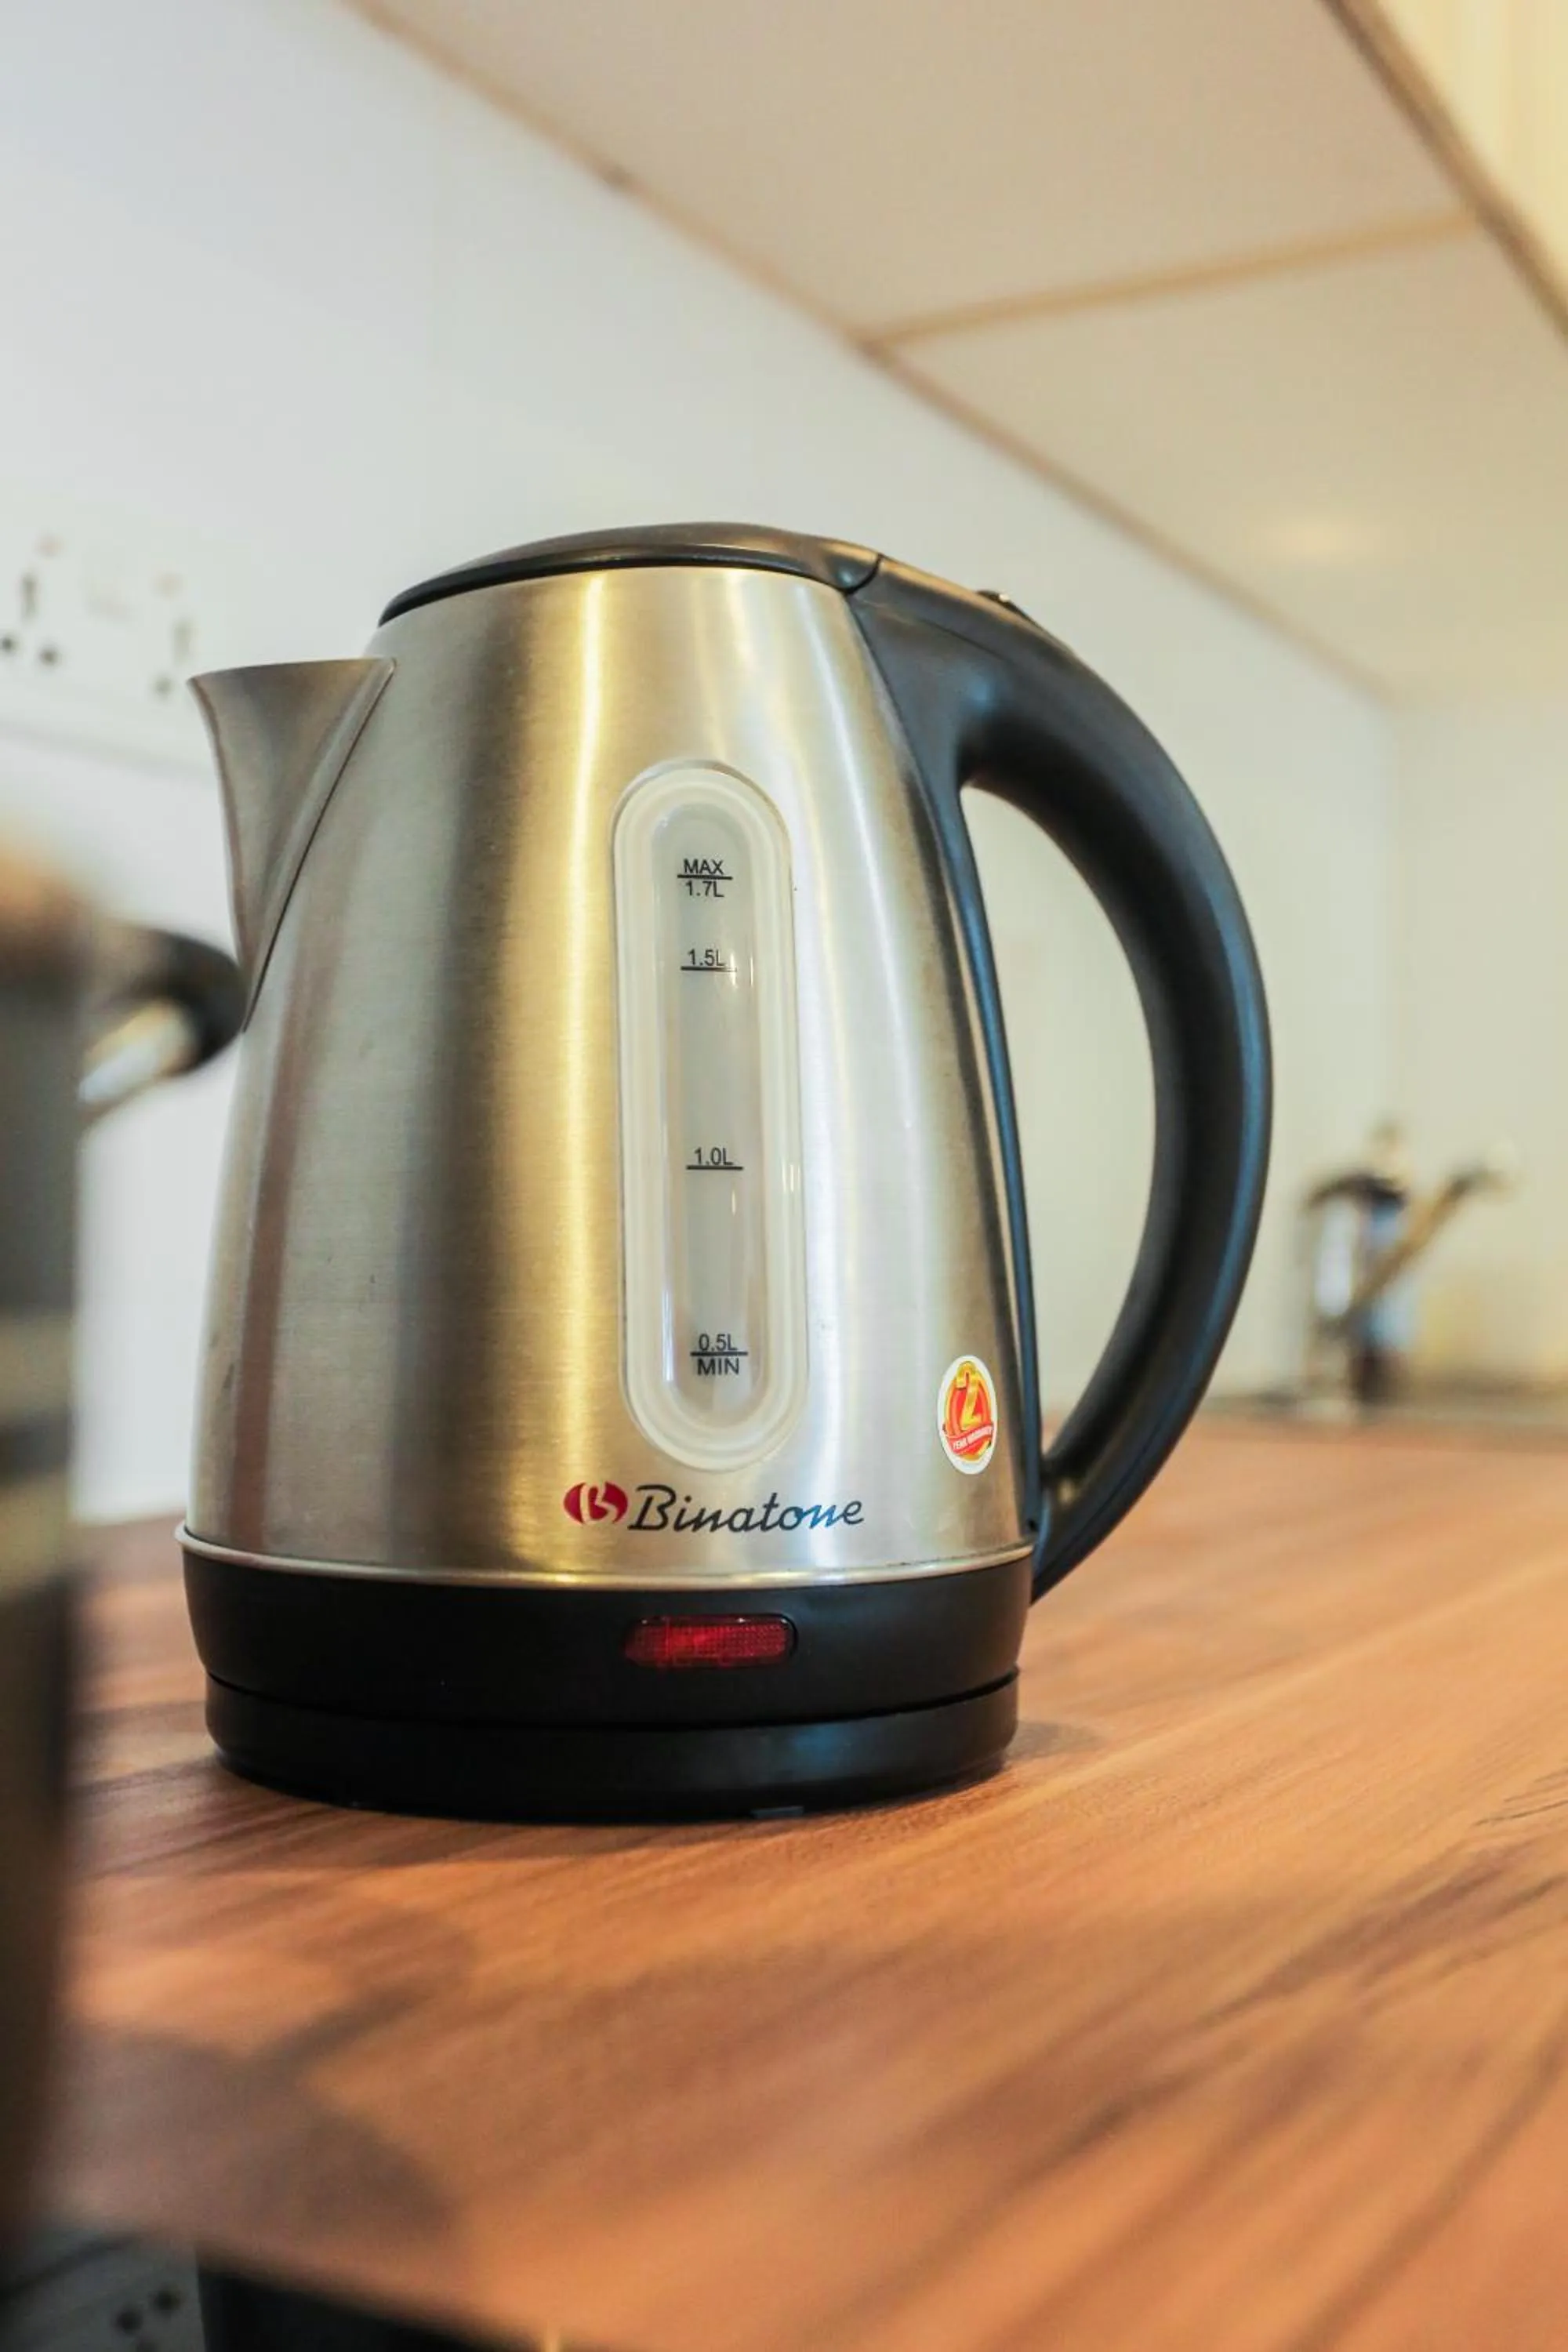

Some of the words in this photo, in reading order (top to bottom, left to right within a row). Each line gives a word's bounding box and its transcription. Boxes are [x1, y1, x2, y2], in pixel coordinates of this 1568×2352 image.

[684, 858, 724, 874] MAX
[685, 880, 724, 897] 1.7L
[688, 949, 725, 967] 1.5L
[694, 1148, 734, 1165] 1.0L
[698, 1334, 738, 1351] 0.5L
[697, 1359, 739, 1375] MIN
[955, 1361, 982, 1431] 2
[628, 1484, 864, 1532] Binatone
